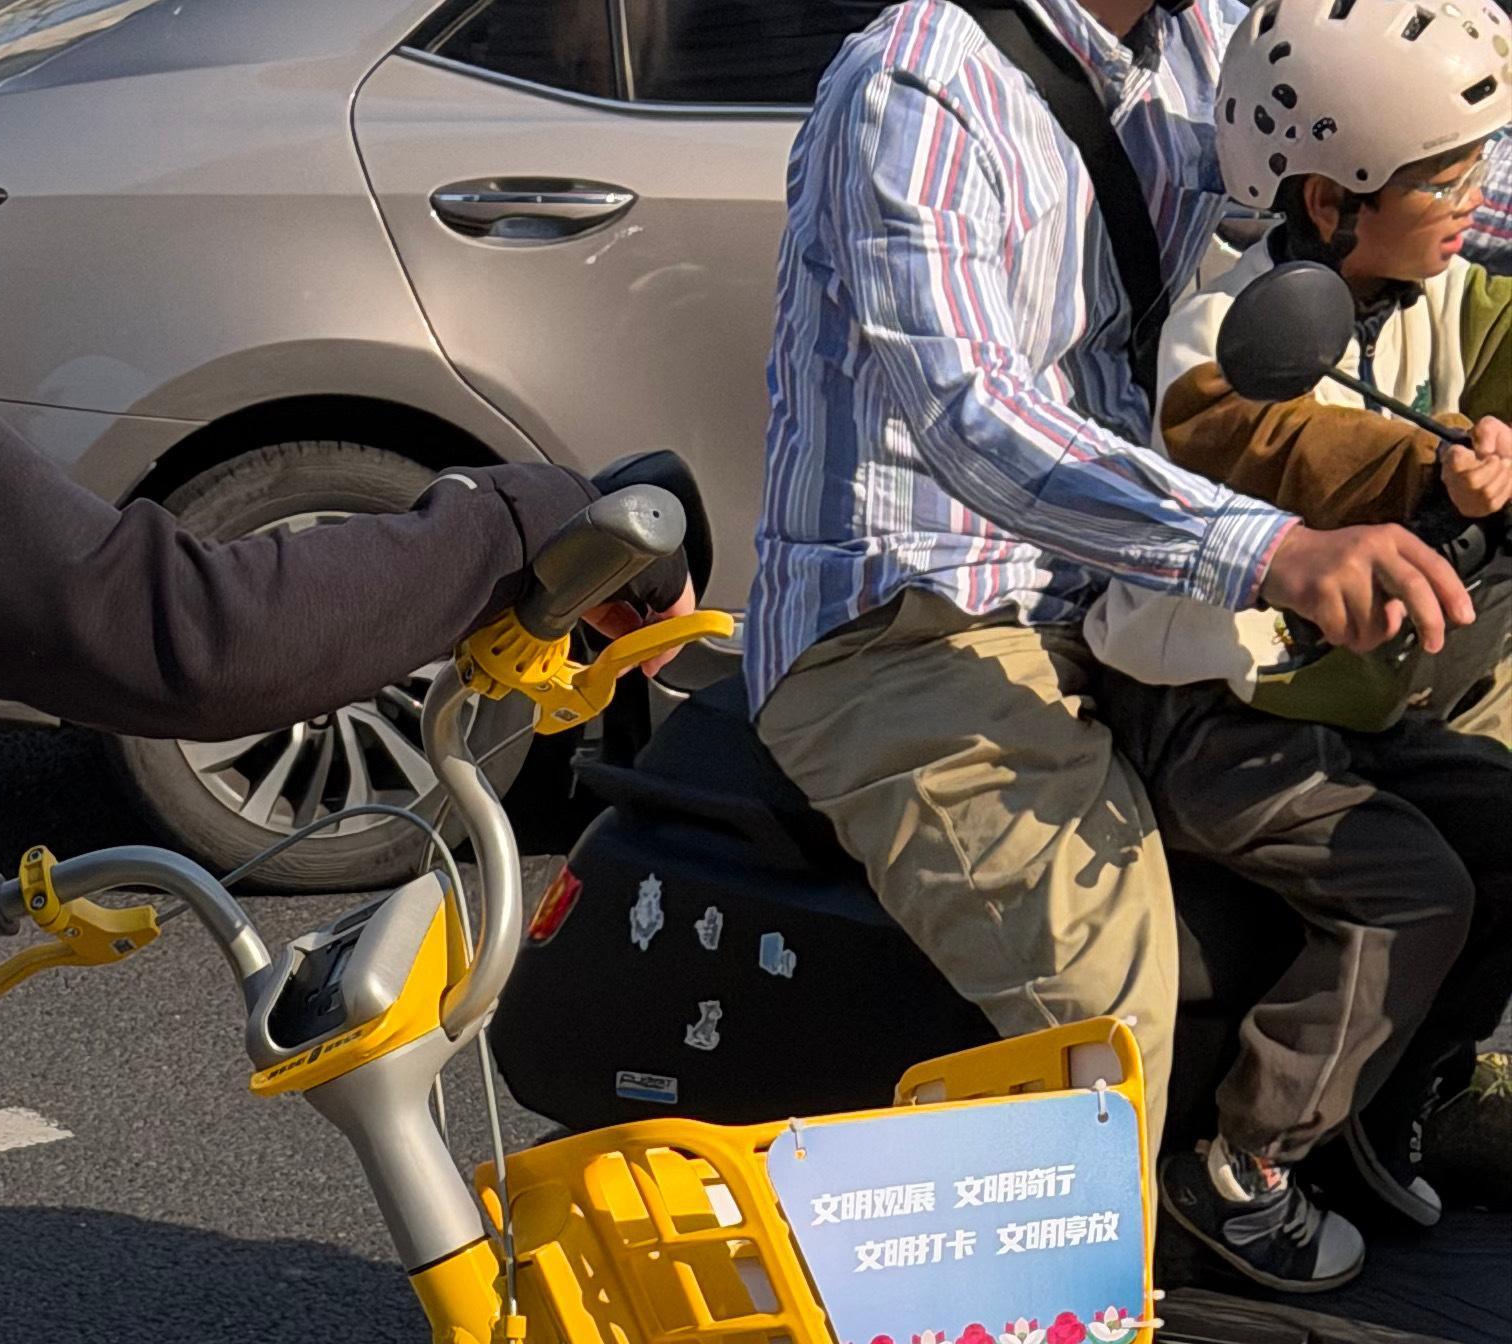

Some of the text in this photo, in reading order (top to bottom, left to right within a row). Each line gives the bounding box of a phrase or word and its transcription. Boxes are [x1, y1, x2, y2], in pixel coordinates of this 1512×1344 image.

[810, 1164, 1076, 1226] 文明观展 文明骑行
[854, 1211, 1119, 1273] 文明打卡 文明停放
